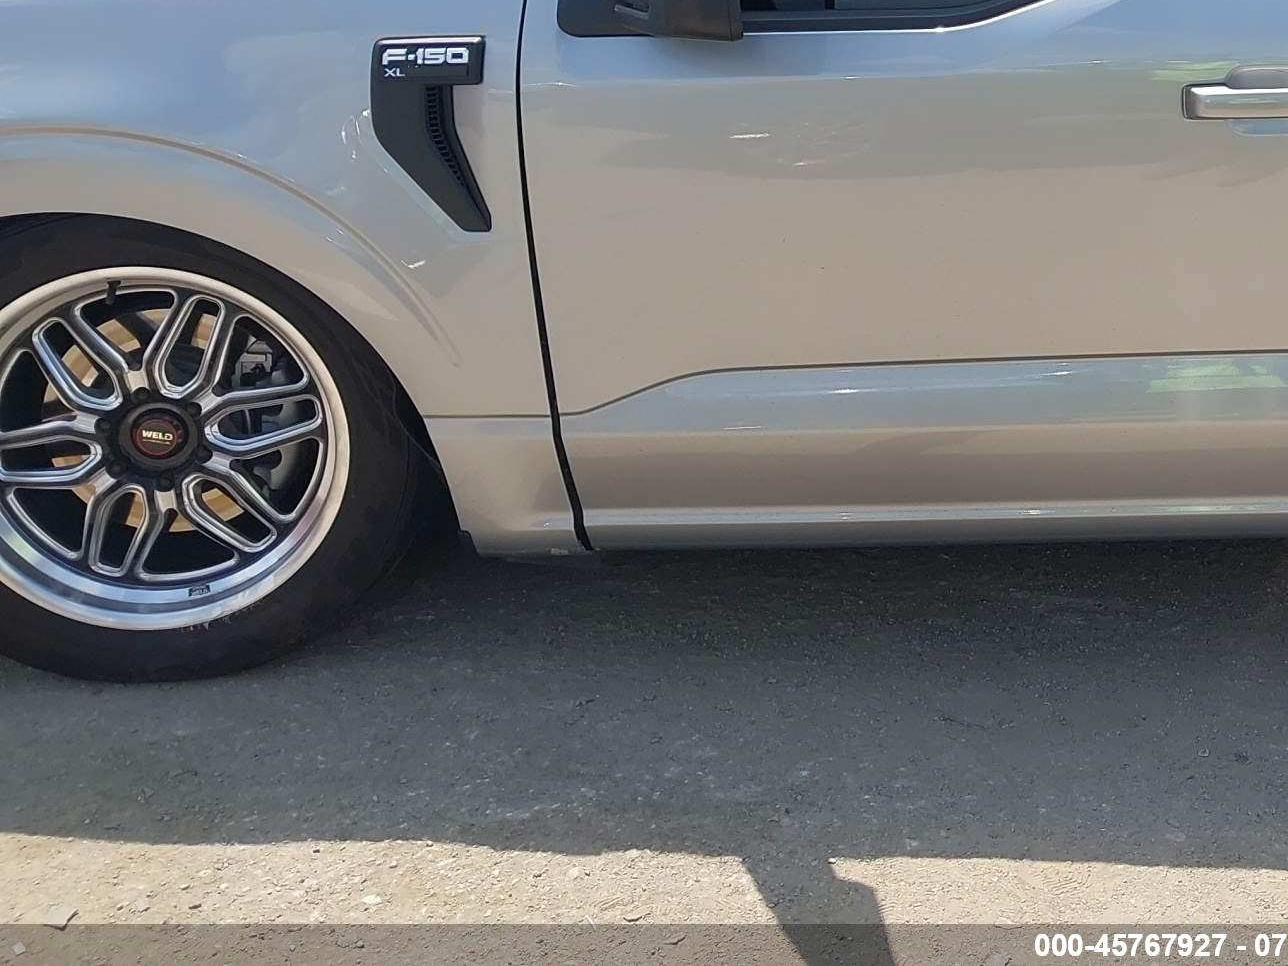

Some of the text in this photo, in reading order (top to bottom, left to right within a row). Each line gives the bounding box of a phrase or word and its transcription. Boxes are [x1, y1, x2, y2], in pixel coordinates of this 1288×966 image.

[382, 47, 469, 65] F-150
[384, 67, 406, 77] XL
[142, 430, 173, 441] WELD
